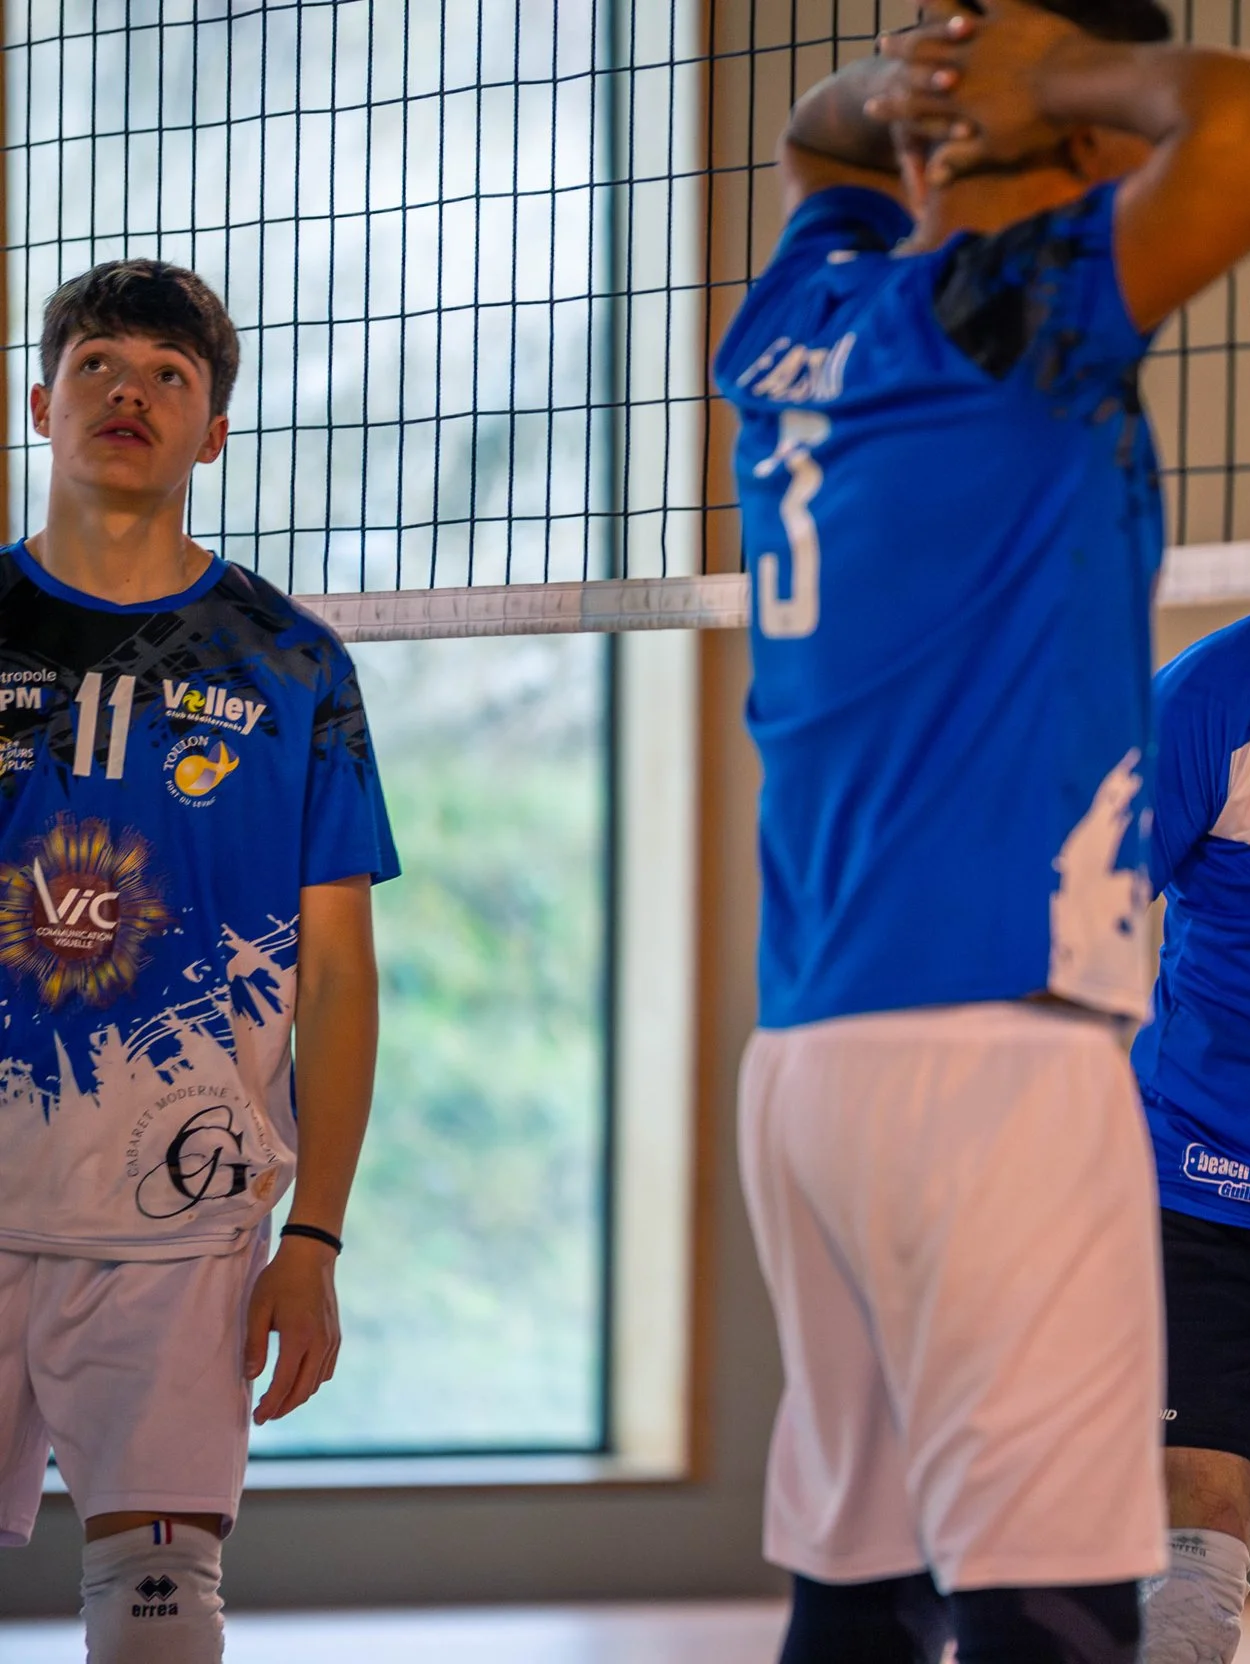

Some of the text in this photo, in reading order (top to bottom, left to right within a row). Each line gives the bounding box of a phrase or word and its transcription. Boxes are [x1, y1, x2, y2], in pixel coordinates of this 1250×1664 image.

[163, 679, 267, 735] Volley
[72, 672, 136, 780] 11
[163, 735, 209, 771] TOULON
[36, 927, 114, 941] COMMUNICATION
[54, 938, 94, 949] VISUELLE
[126, 1085, 230, 1177] CABARET MODERNE
[1197, 1150, 1250, 1180] beach
[131, 1602, 178, 1617] errea
